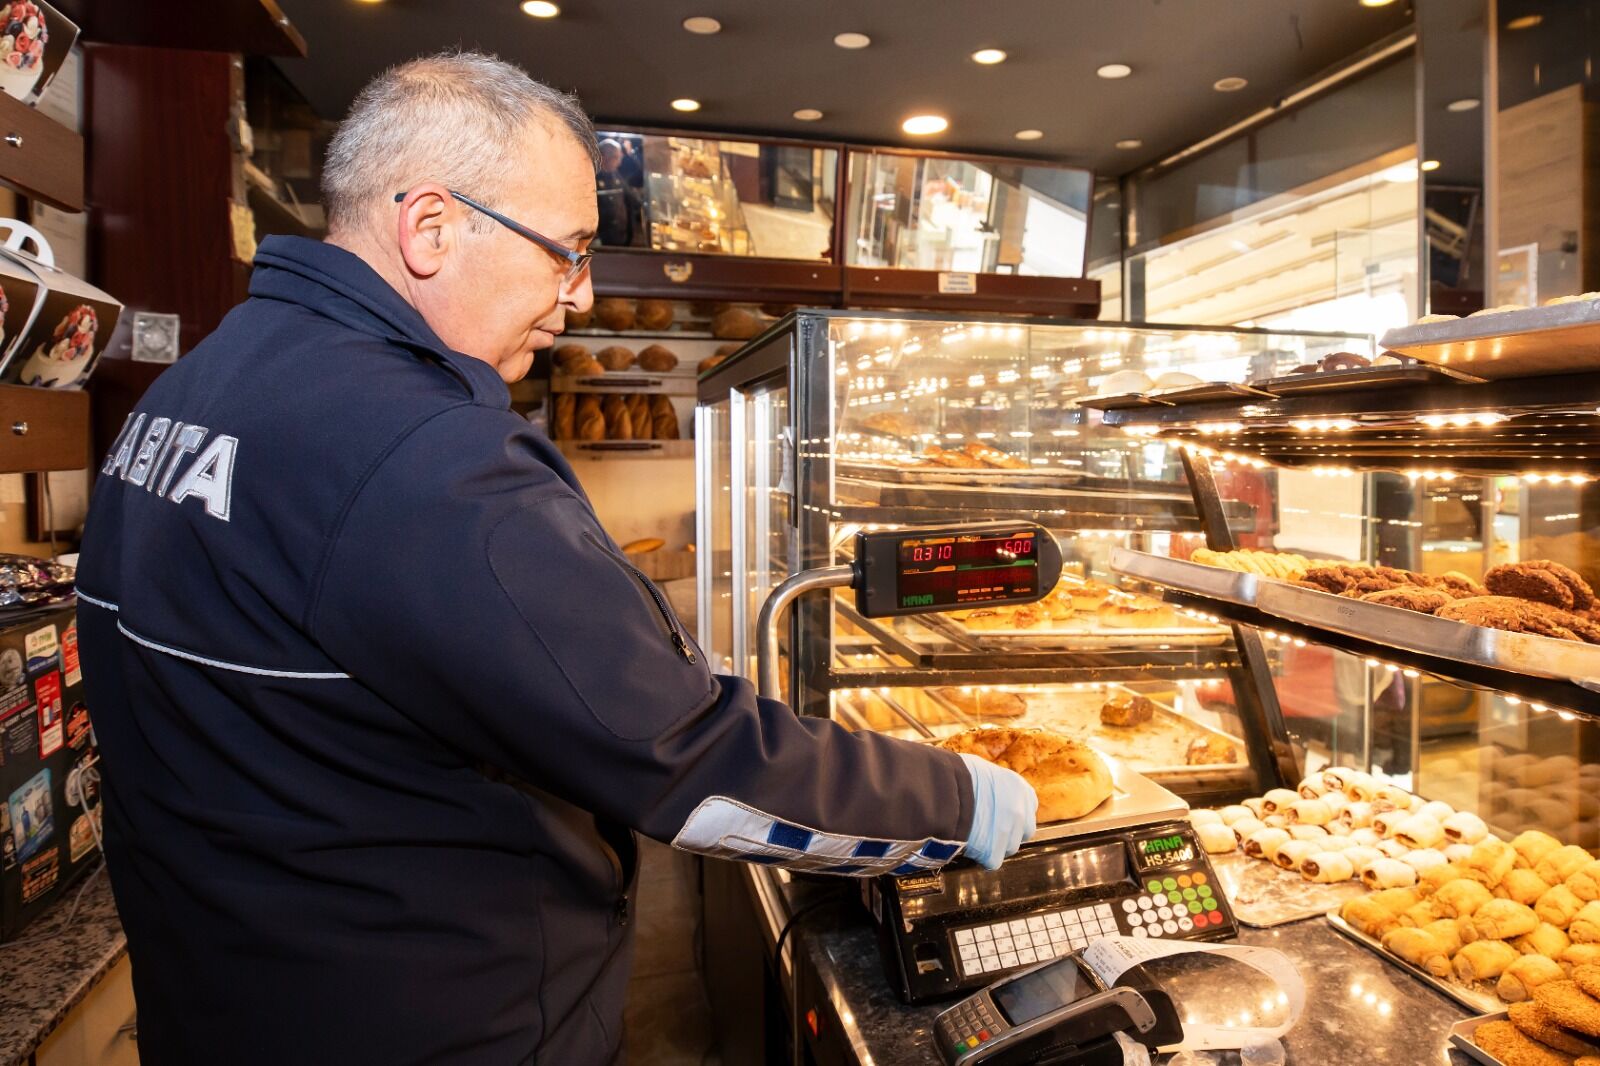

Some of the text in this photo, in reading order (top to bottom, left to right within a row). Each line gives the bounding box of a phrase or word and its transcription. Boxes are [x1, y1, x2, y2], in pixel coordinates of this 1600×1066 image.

[102, 412, 238, 522] ABITA
[903, 594, 934, 606] HANA
[1145, 835, 1184, 853] HANA
[1144, 847, 1194, 867] HS-5400
